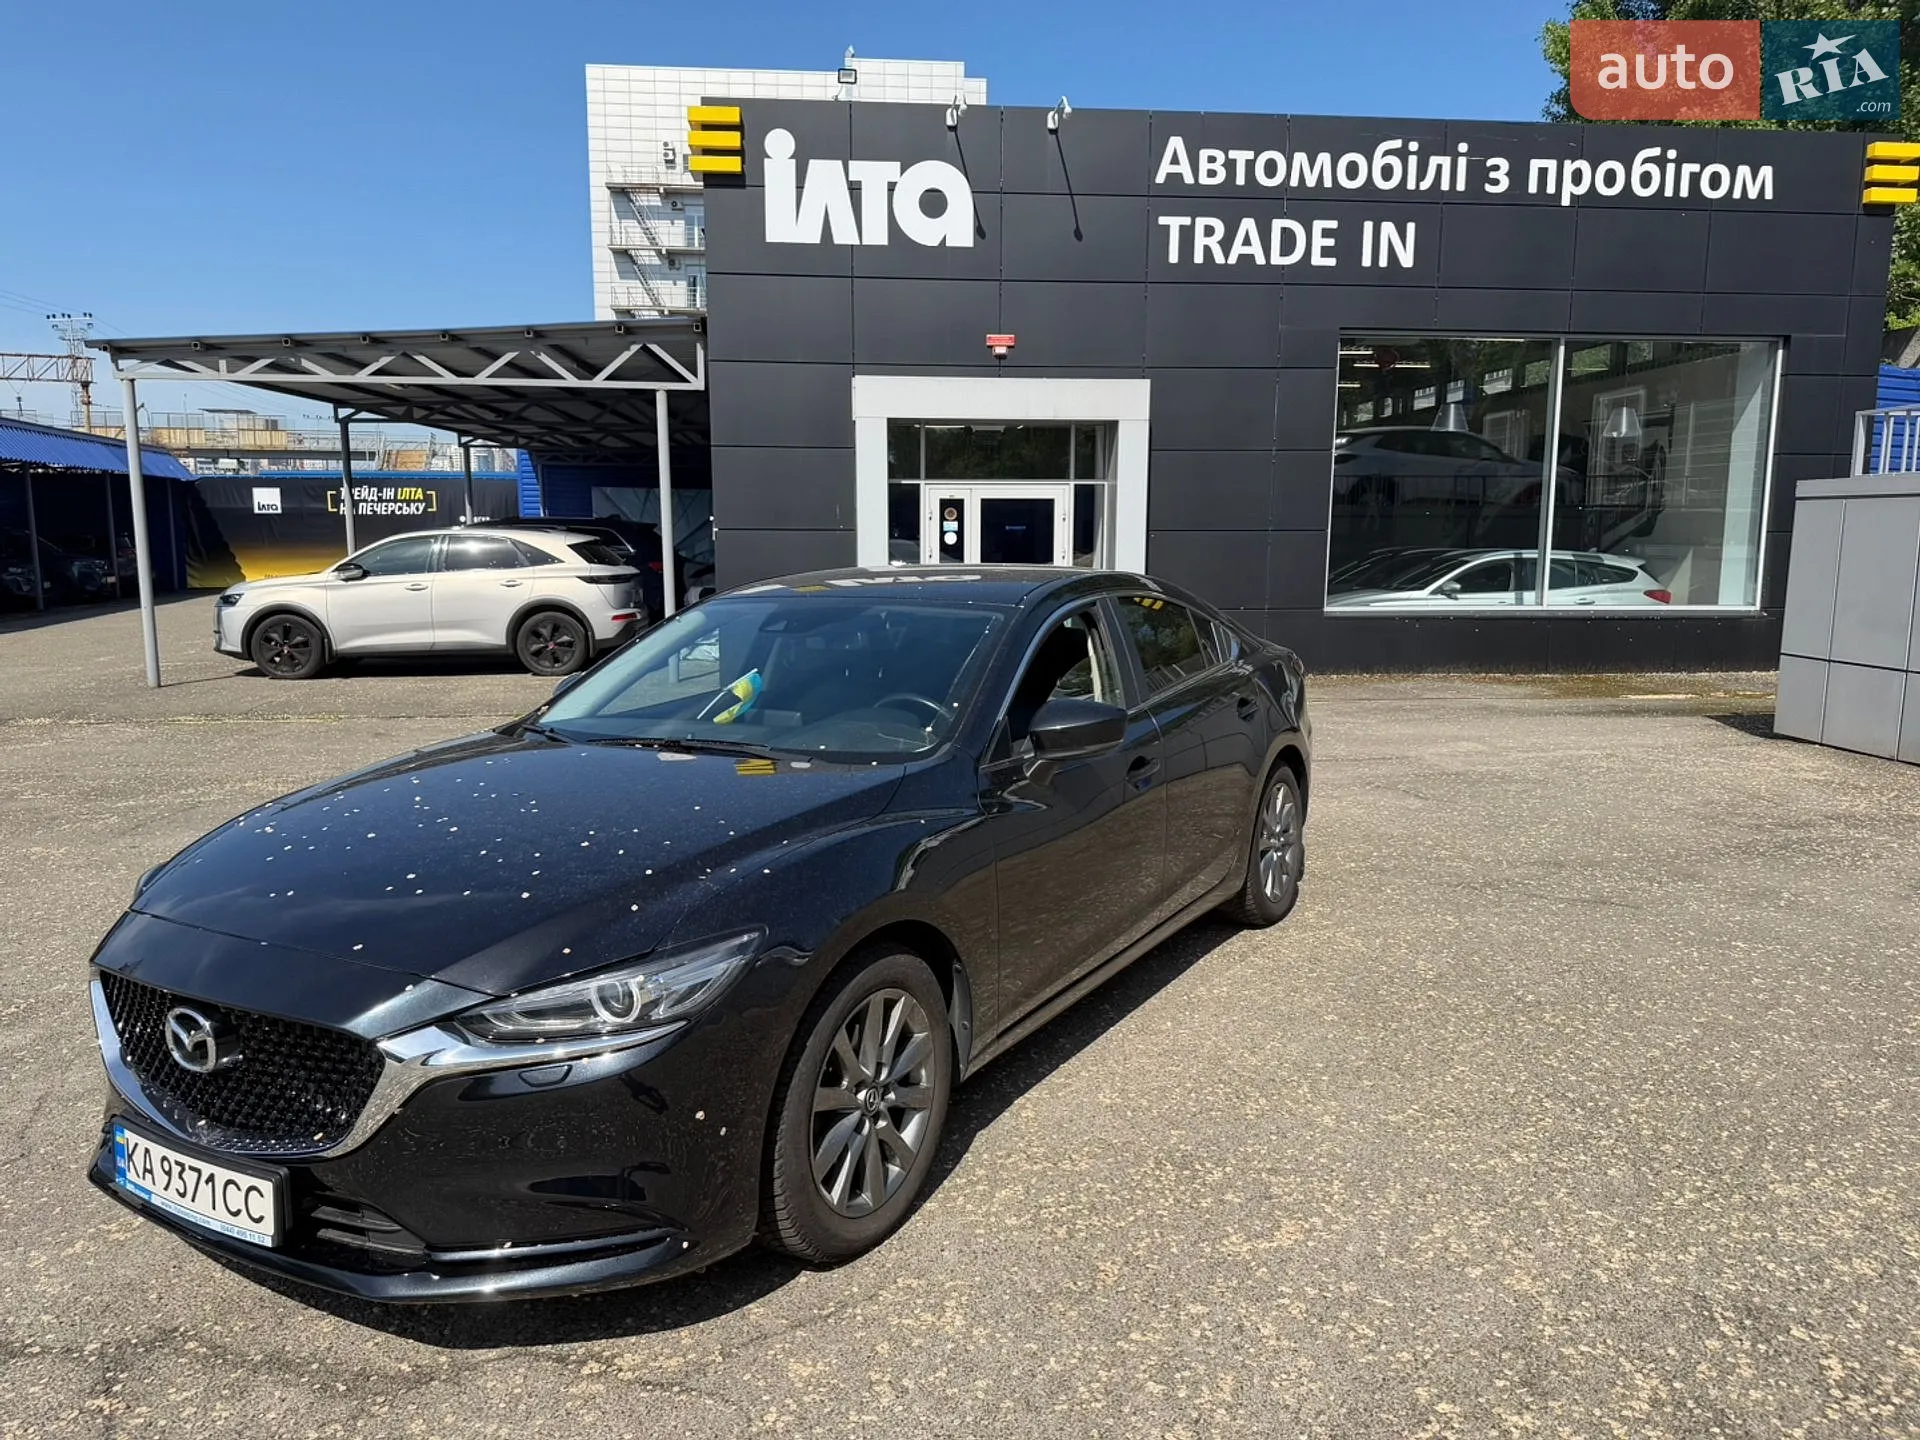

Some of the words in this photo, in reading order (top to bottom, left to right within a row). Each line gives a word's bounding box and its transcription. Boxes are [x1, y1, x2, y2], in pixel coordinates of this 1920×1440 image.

[1155, 137, 1468, 192] Автомобілі
[1485, 158, 1509, 193] з
[1529, 147, 1773, 206] пробігом
[1158, 217, 1338, 266] TRADE
[1362, 221, 1415, 268] IN
[340, 486, 394, 501] ТЕЙД-ІН
[397, 487, 424, 500] ІЛТА
[340, 503, 356, 515] Н
[358, 502, 426, 515] ПЕЧЕРСЬКУ
